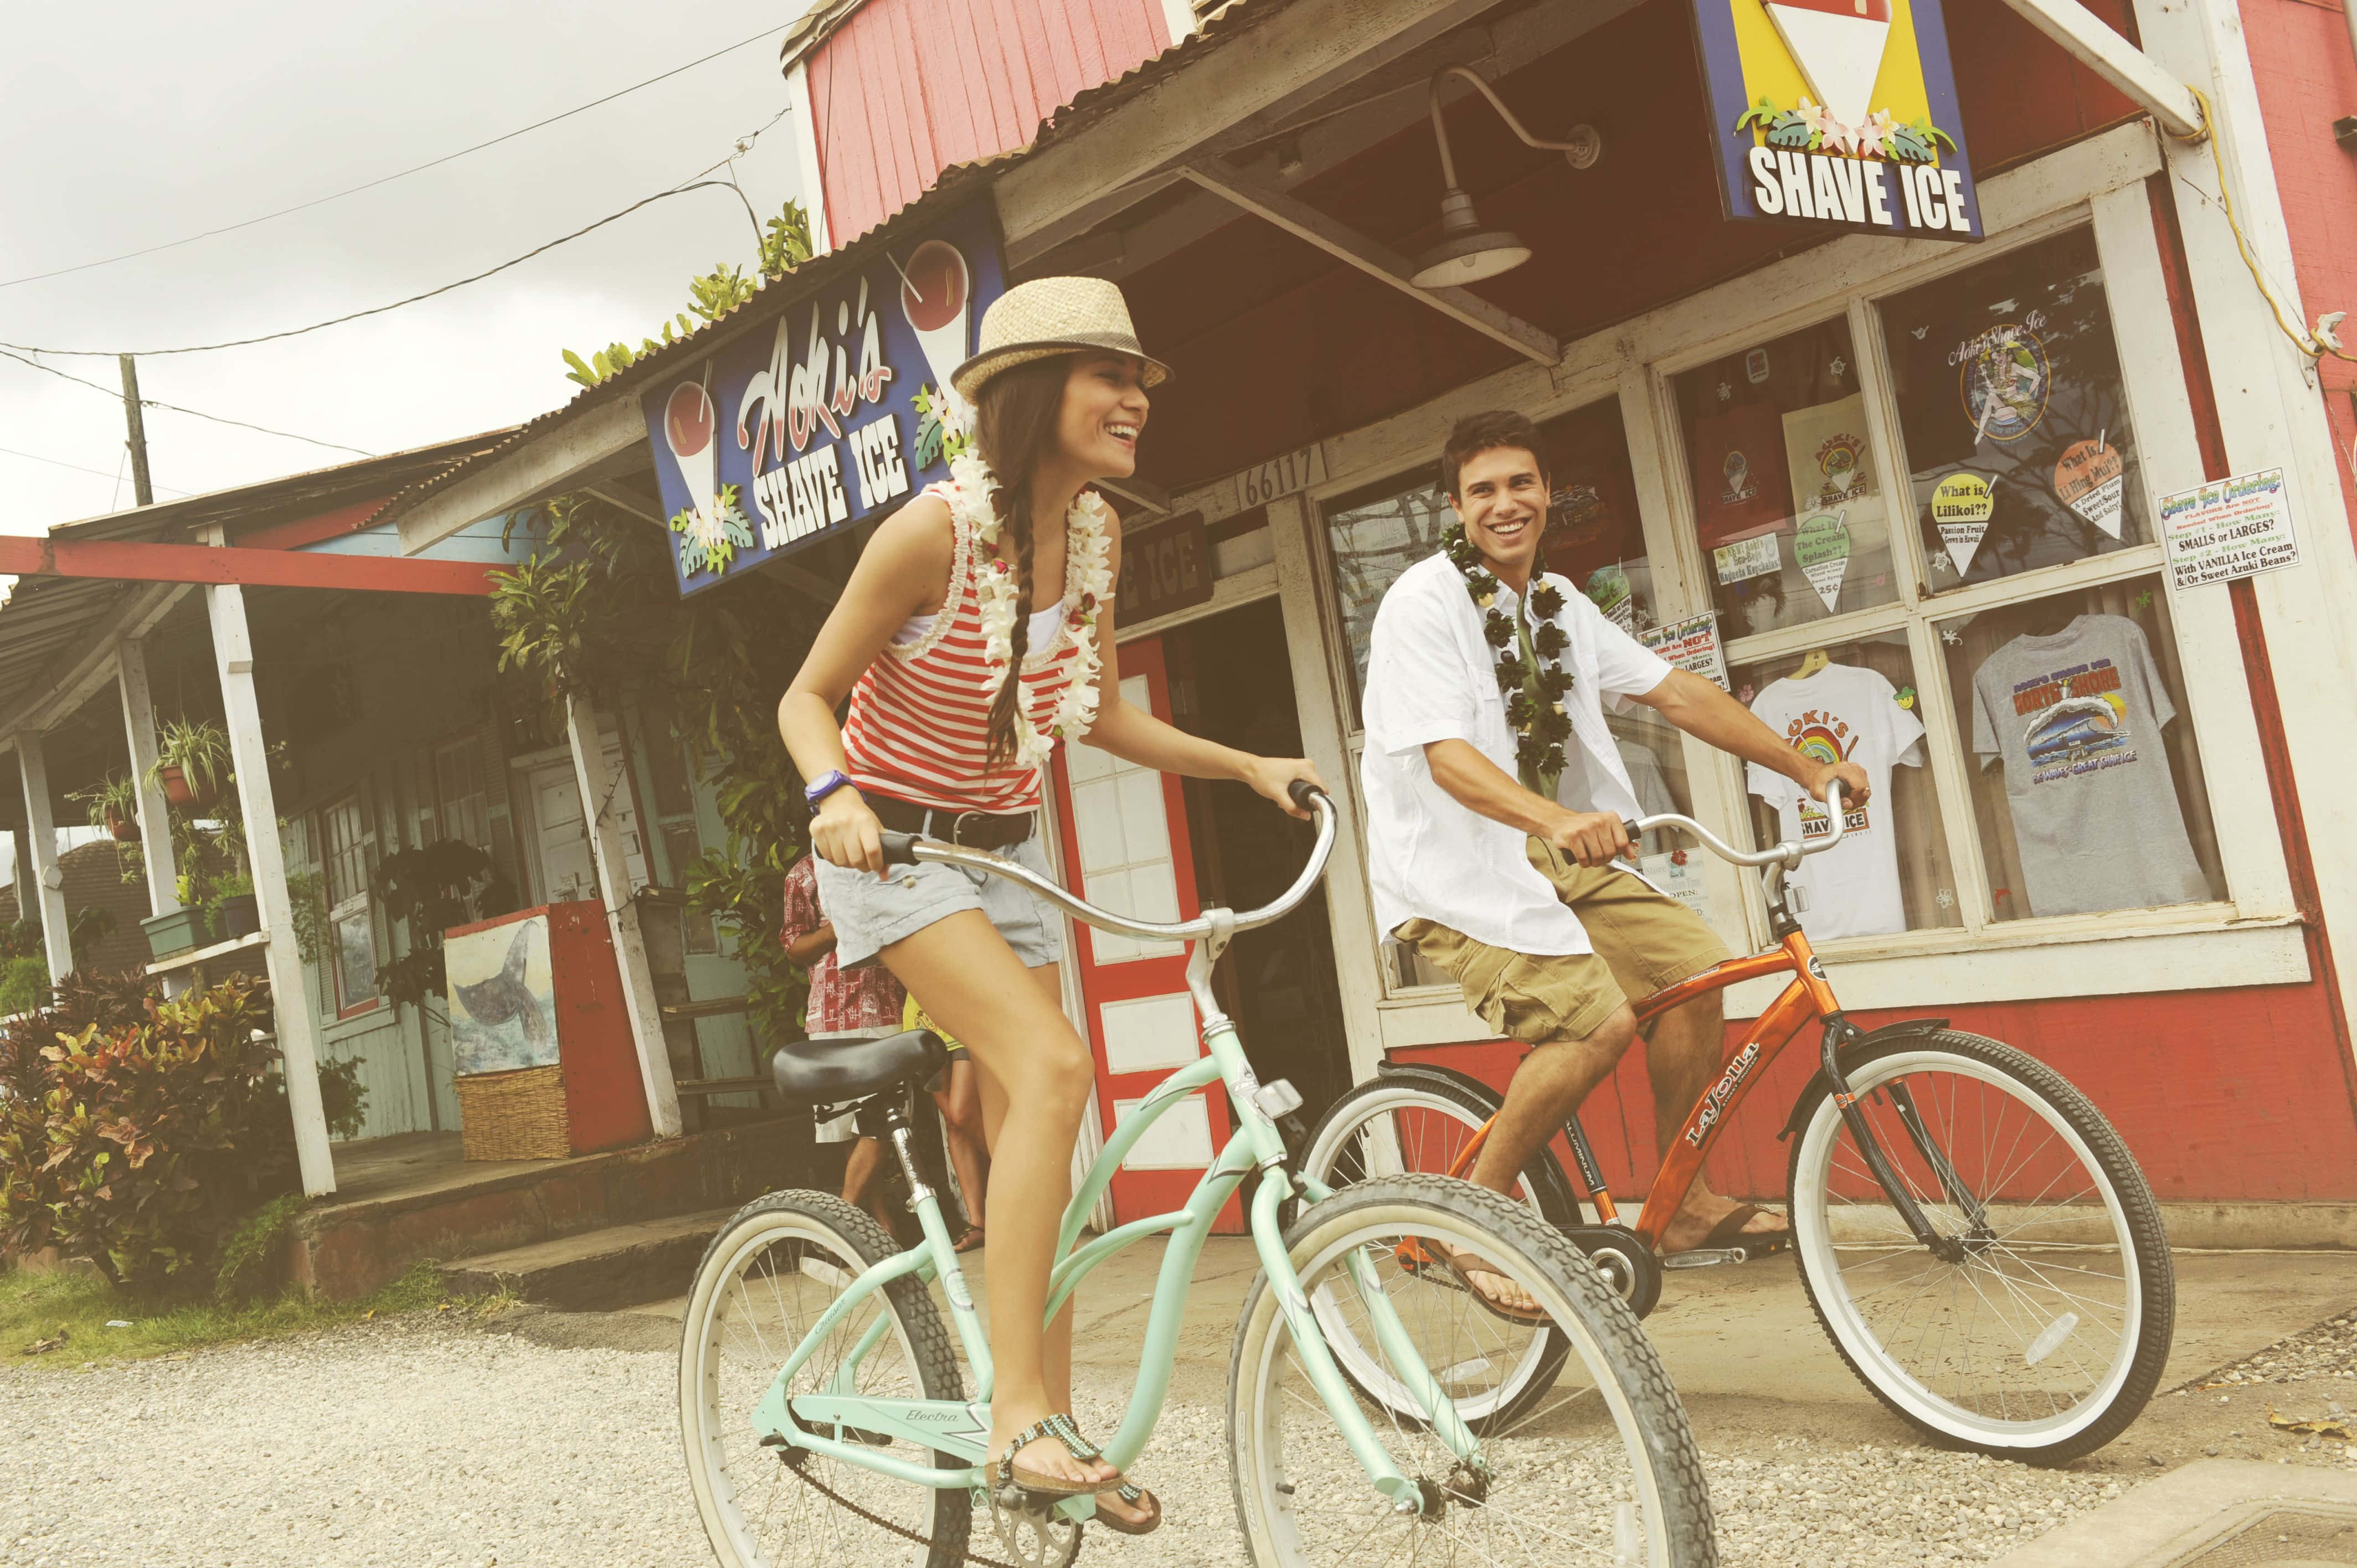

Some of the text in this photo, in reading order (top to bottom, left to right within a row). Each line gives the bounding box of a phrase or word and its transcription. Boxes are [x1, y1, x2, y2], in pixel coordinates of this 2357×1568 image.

[1749, 146, 1971, 231] SHAVE ICE
[2024, 310, 2046, 334] Ice
[2062, 446, 2096, 472] What Is
[753, 413, 908, 551] SHAVE ICE
[1247, 447, 1311, 506] 66117
[2060, 487, 2070, 500] Li
[2069, 474, 2093, 496] Hing
[1852, 487, 1864, 496] ICE
[1940, 485, 1984, 498] What is
[2081, 492, 2101, 505] Dried
[2101, 479, 2121, 494] Plum
[2083, 490, 2120, 516] Sweet/Sour
[2162, 472, 2281, 520] Shave Ice Ordering:
[1937, 504, 1987, 517] Lilikoi??
[2091, 512, 2103, 523] And
[2176, 502, 2273, 530] Needed When Ordering!
[2184, 506, 2223, 519] FLAVORS
[2242, 497, 2261, 506] NOT
[1802, 521, 1839, 535] What Is
[1941, 527, 1965, 535] Passion
[2168, 531, 2191, 541] Step
[2216, 519, 2241, 529] How
[2245, 509, 2281, 522] Many:
[2179, 519, 2274, 552] SMALLS or LARGES?
[1727, 544, 1744, 558] NEW!
[1796, 533, 1845, 551] The Cream
[1945, 536, 1958, 544] Grown
[2173, 554, 2196, 565] Step
[2221, 542, 2246, 553] How
[2250, 533, 2286, 545] Many:
[1803, 545, 1842, 563] Splash??
[2175, 543, 2293, 576] With VANILLA Ice Cream
[1719, 557, 1781, 582] Magnets Keychains!
[1805, 564, 1828, 574] Carnation
[2177, 551, 2296, 587] &/Or Sweet Azuki Beans?
[1819, 584, 1839, 594] 25¢
[1677, 616, 1712, 640] Ordering:
[1682, 633, 1711, 648] NOT
[1686, 643, 1715, 656] Ordering!
[1685, 658, 1713, 672] LARGES?
[2013, 666, 2122, 716] NORTH SHORE
[2121, 750, 2137, 765] ICE
[1845, 813, 1864, 828] ICE
[1670, 890, 1697, 899] OPEN:
[1685, 966, 1720, 982] ALUMINUM
[1722, 1056, 1758, 1107] STREET CRUISER
[1565, 1120, 1594, 1185] ALUMINUM
[815, 1298, 846, 1334] Cruiser
[906, 1410, 959, 1422] Electra
